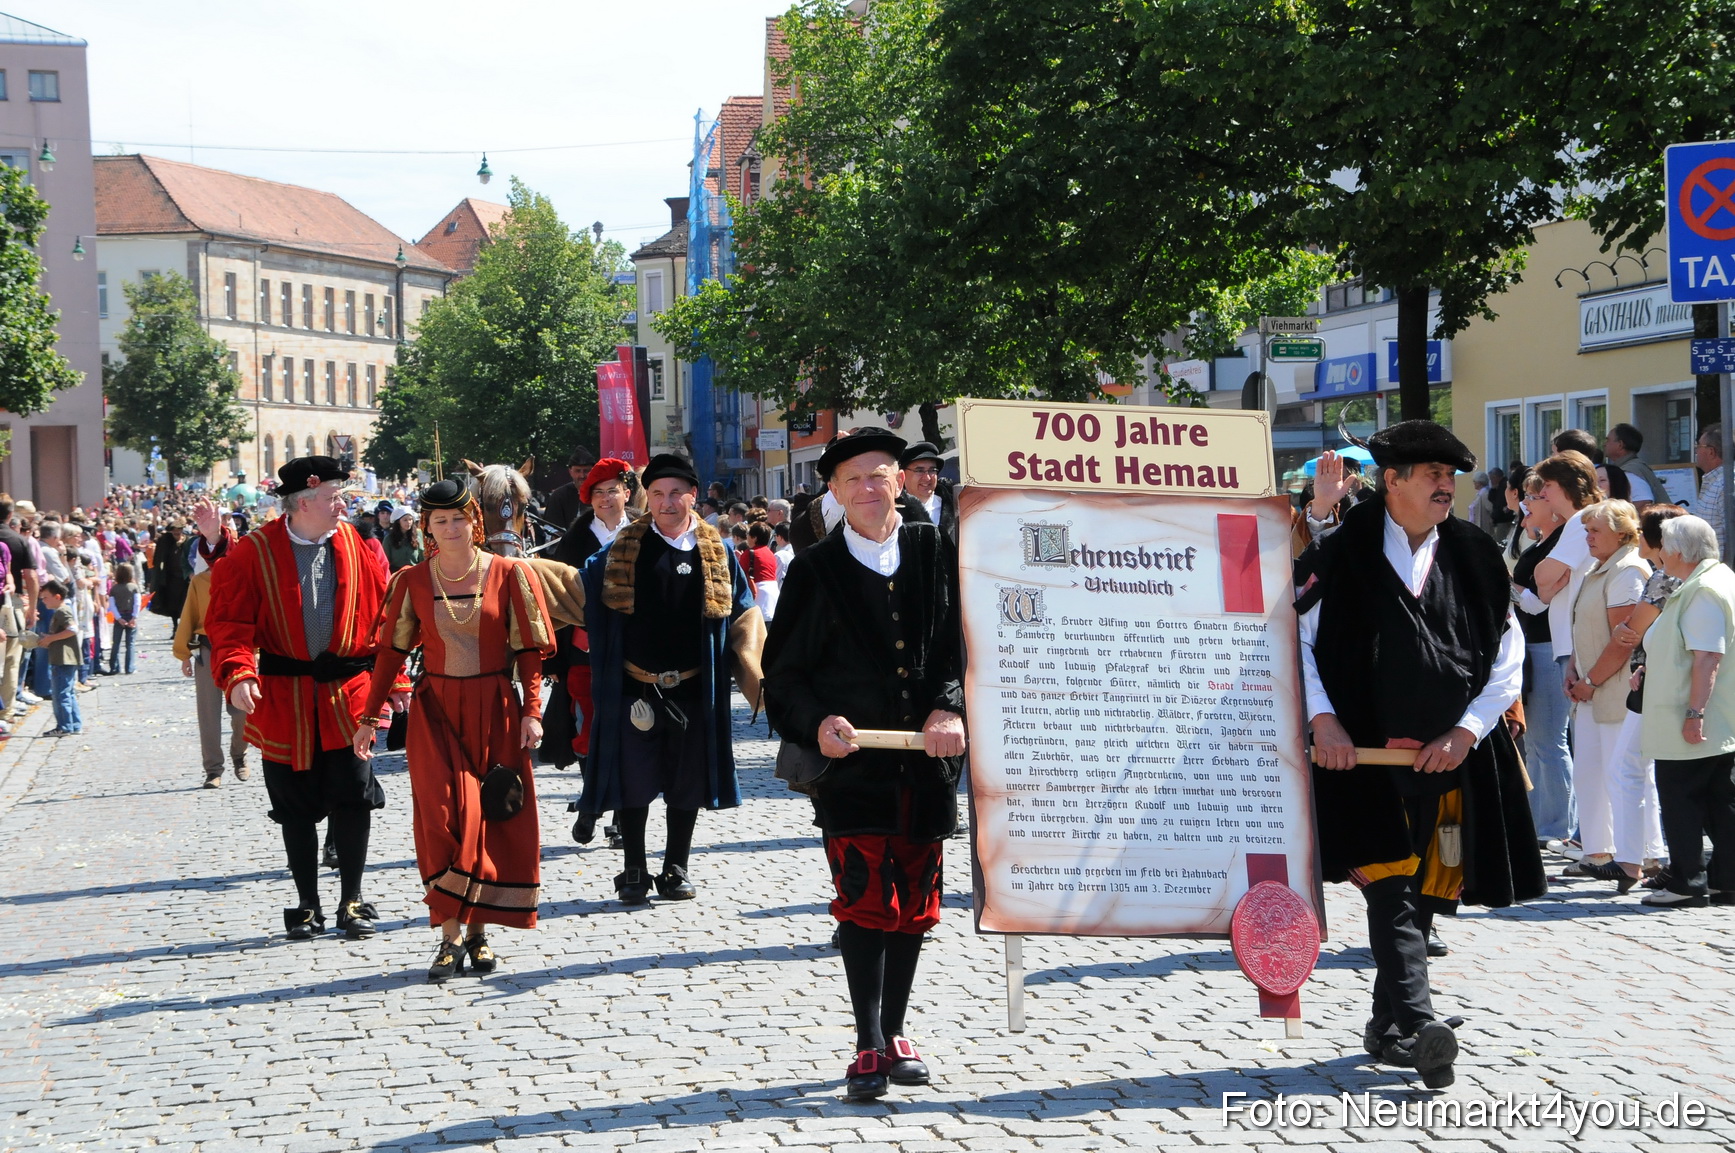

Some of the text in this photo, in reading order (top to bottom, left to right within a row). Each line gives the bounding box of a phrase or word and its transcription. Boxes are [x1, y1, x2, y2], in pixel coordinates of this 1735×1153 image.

[1679, 255, 1735, 289] TA
[1270, 320, 1313, 331] Viehmarkt
[1584, 297, 1652, 336] GASTHAUS
[1032, 411, 1209, 449] 700 Jahre
[1007, 451, 1240, 489] Stadt Hemau
[1020, 523, 1198, 572] Lehensbrief
[1083, 576, 1176, 598] Urkundlich
[1061, 615, 1093, 626] Bruder
[1156, 619, 1188, 630] Gottes
[1193, 620, 1228, 631] Gnaden
[1233, 622, 1268, 632] Bischof
[1015, 628, 1056, 642] Bamberg
[1064, 631, 1115, 642] beurkunden
[1173, 636, 1190, 644] und
[1198, 636, 1223, 647] geben
[998, 643, 1015, 655] daß
[1097, 648, 1112, 657] der
[1119, 648, 1163, 658] erhabenen
[1170, 649, 1207, 661] Fürsten
[1214, 652, 1232, 660] und
[1239, 651, 1270, 662] Herren
[998, 658, 1030, 669] Rudolf
[1038, 661, 1056, 670] und
[1104, 662, 1149, 675] Pfalzgraf
[1157, 664, 1171, 673] bei
[1179, 664, 1205, 675] Rhein
[1213, 667, 1231, 676] und
[1239, 666, 1272, 678] Herzog
[1000, 676, 1017, 684] von
[1065, 675, 1103, 688] folgende
[1147, 678, 1181, 689] nämlich
[1187, 681, 1200, 690] die
[1207, 680, 1234, 691] Stadt
[1241, 681, 1273, 692] Hemau
[1000, 690, 1018, 699] und
[1021, 691, 1038, 699] das
[1040, 692, 1066, 702] ganze
[1069, 690, 1099, 702] Gebiet
[1165, 694, 1178, 704] die
[1181, 694, 1217, 706] Diözese
[1220, 695, 1274, 708] Regensburg
[1001, 706, 1017, 714] mit
[1054, 706, 1080, 718] adelig
[1083, 708, 1101, 717] und
[1043, 721, 1072, 731] bebaut
[1080, 723, 1097, 732] und
[1259, 728, 1277, 737] und
[1074, 739, 1096, 749] ganz
[1103, 738, 1129, 750] gleich
[1135, 739, 1170, 749] welchen
[1176, 739, 1201, 750] Wert
[1208, 743, 1221, 751] sie
[1228, 741, 1254, 752] haben
[1260, 741, 1278, 752] und
[1004, 750, 1025, 760] allen
[1080, 754, 1100, 762] was
[1106, 754, 1121, 763] der
[1183, 755, 1205, 766] Herr
[1256, 756, 1279, 768] Graf
[1005, 767, 1022, 775] von
[1028, 765, 1079, 779] Hirschberg
[1193, 773, 1210, 781] von
[1216, 773, 1234, 781] uns
[1240, 773, 1257, 782] und
[1263, 775, 1281, 783] von
[1006, 783, 1041, 794] unserer
[1045, 781, 1096, 795] Bamberger
[1100, 783, 1130, 794] Kirche
[1134, 785, 1149, 794] als
[1220, 788, 1237, 796] und
[1242, 788, 1282, 798] besessen
[1031, 797, 1056, 808] ihnen
[1062, 799, 1078, 808] den
[1085, 798, 1128, 811] Herzögen
[1134, 799, 1166, 810] Rudolf
[1173, 802, 1190, 810] und
[1236, 804, 1254, 812] und
[1260, 804, 1283, 814] ihren
[1007, 811, 1035, 822] Erben
[1118, 817, 1135, 825] von
[1140, 817, 1158, 826] uns
[1162, 818, 1175, 826] zu
[1179, 818, 1211, 829] ewigen
[1245, 820, 1262, 828] von
[1267, 821, 1285, 829] uns
[1008, 829, 1026, 838] und
[1031, 830, 1066, 839] unserer
[1071, 828, 1101, 840] Kirche
[1106, 832, 1118, 840] zu
[1157, 833, 1169, 841] zu
[1173, 832, 1201, 842] halten
[1206, 834, 1224, 842] und
[1228, 835, 1240, 844] zu
[1010, 863, 1060, 876] Geschehen
[1063, 867, 1082, 876] und
[1084, 866, 1122, 878] gegeben
[1125, 869, 1137, 877] im
[1140, 866, 1162, 879] Feld
[1164, 868, 1179, 878] bei
[1011, 882, 1024, 890] im
[1028, 880, 1055, 893] Jahre
[1058, 882, 1075, 891] des
[1078, 881, 1107, 893] Herrn
[1164, 883, 1212, 895] Dezember
